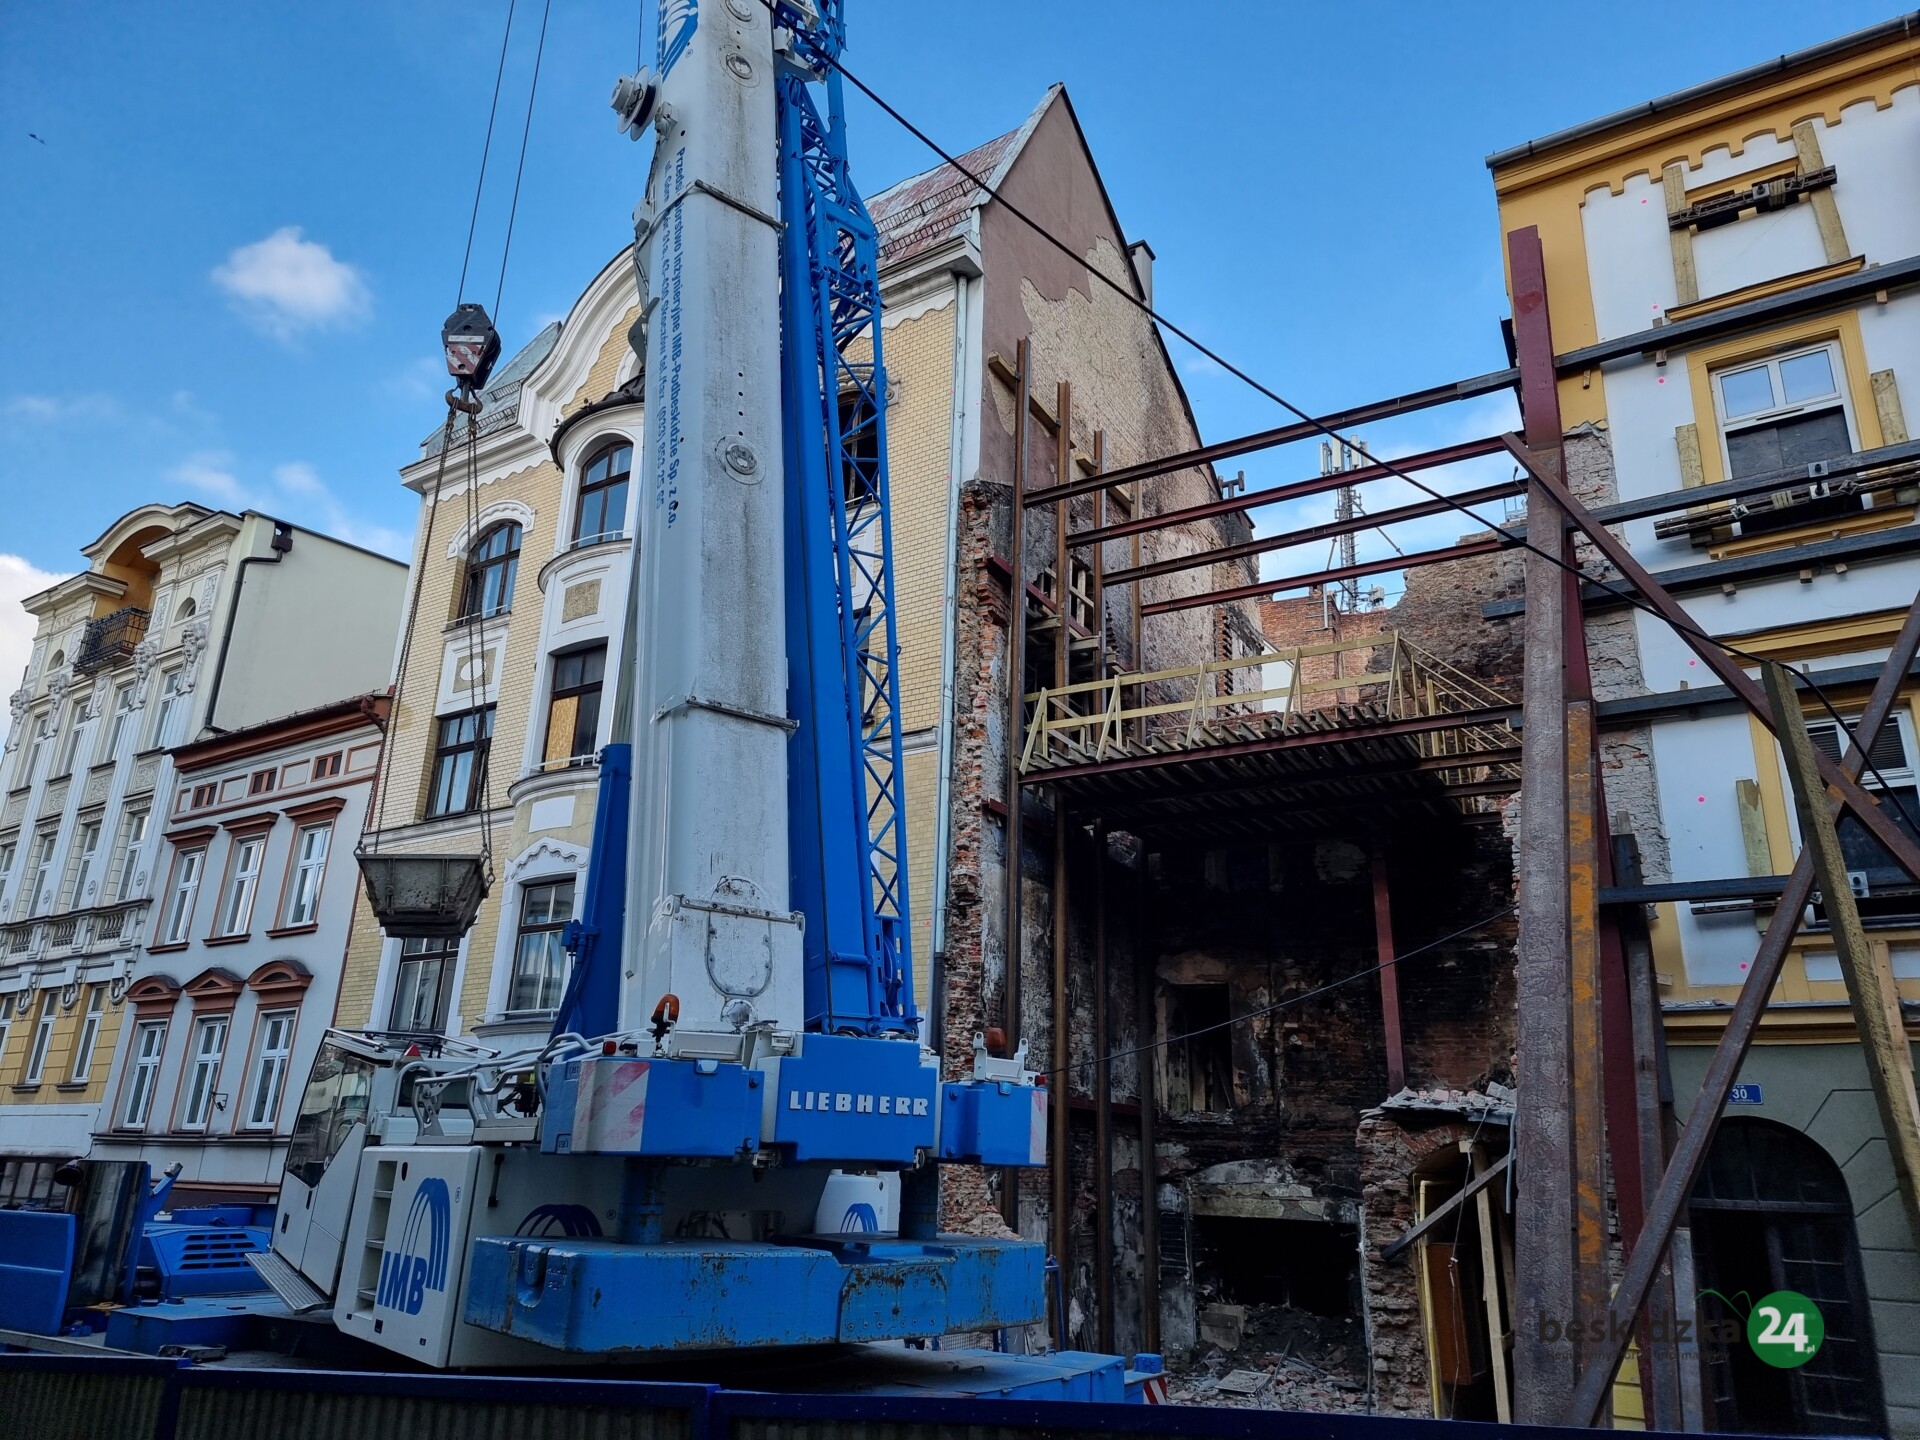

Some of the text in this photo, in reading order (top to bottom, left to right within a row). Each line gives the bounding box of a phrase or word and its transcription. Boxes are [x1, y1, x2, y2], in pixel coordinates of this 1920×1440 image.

[660, 300, 669, 355] Skoczów
[667, 147, 686, 529] Przedsiiorstwo Inżynieryjne IMB-Podbeskidzie Sp. z o.o.
[789, 1090, 929, 1116] LIEBHERR
[1732, 1088, 1748, 1099] 30
[377, 1250, 427, 1315] IMB
